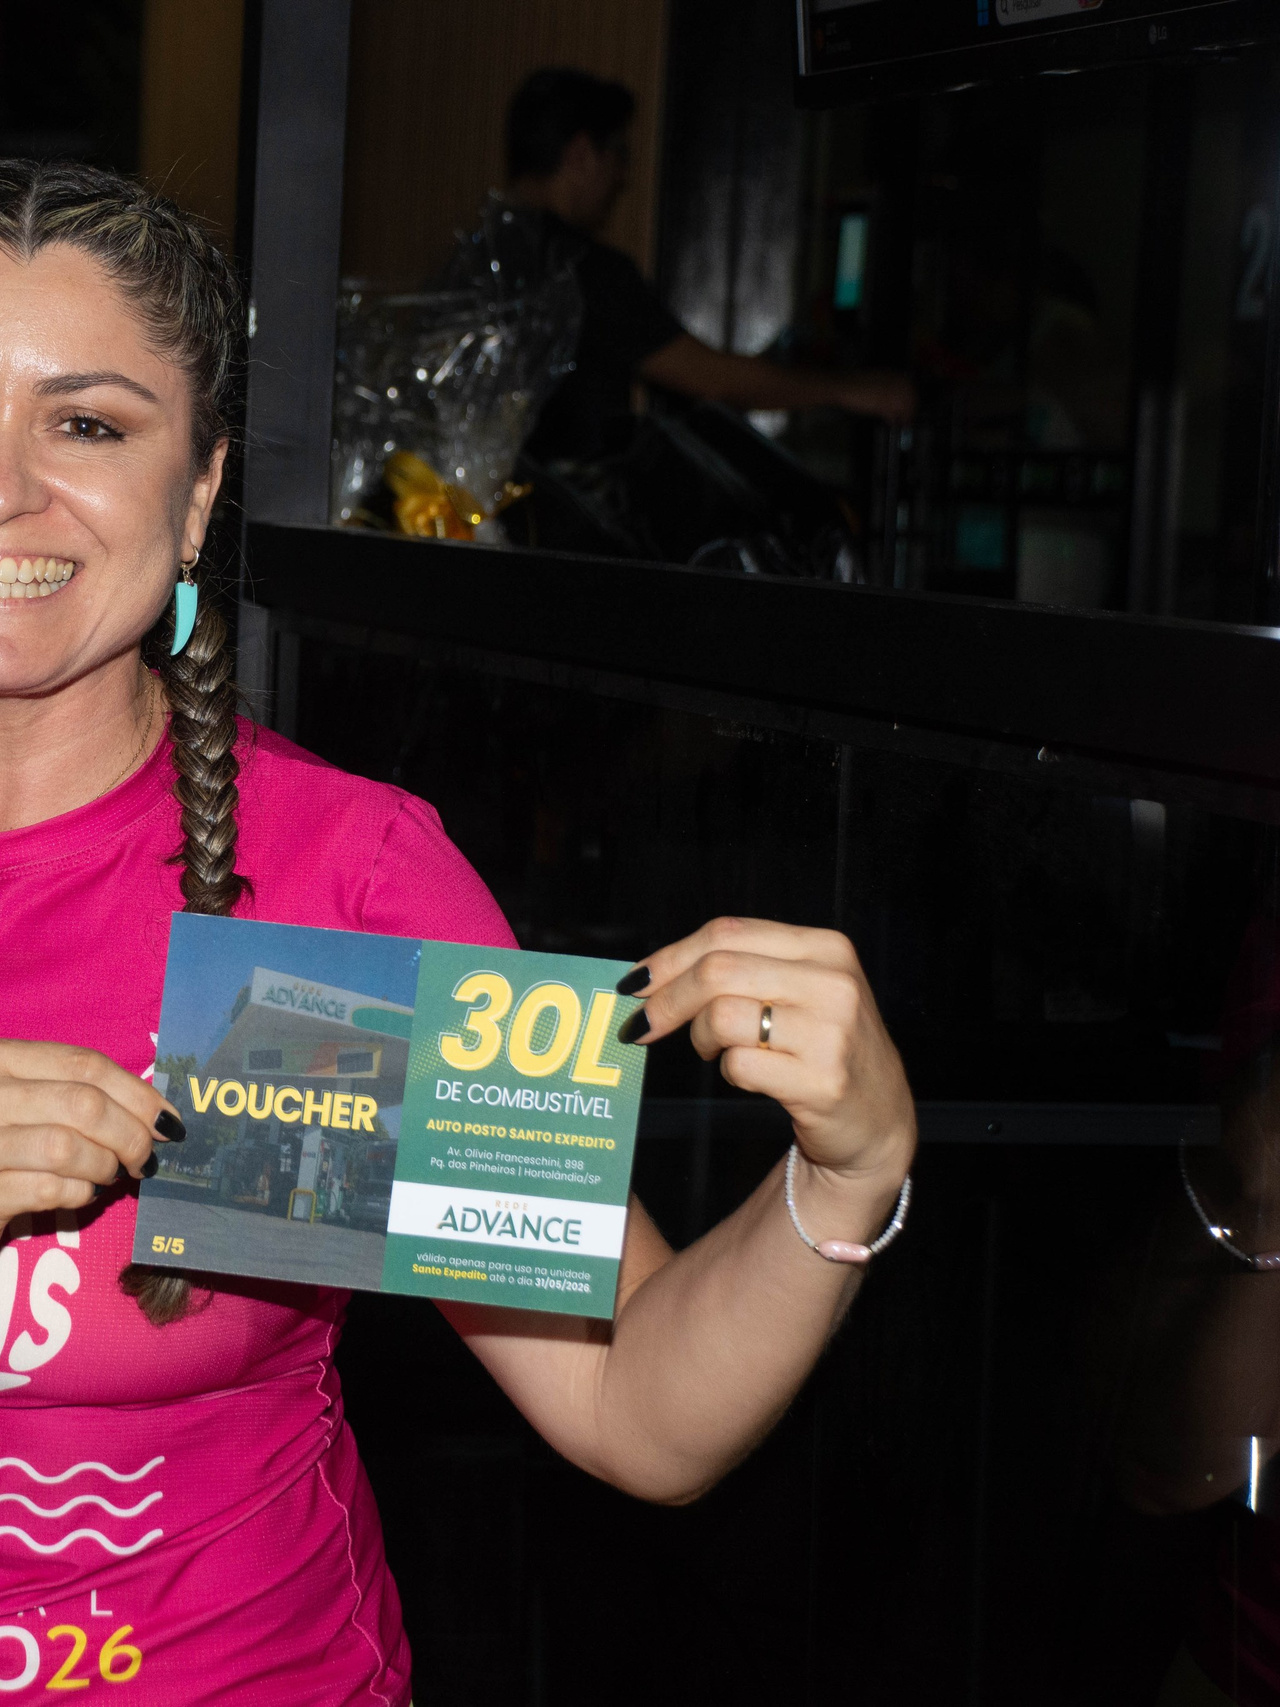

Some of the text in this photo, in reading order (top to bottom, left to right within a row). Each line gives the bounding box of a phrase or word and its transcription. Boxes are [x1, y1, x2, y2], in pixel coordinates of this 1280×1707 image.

[1157, 25, 1168, 40] LG
[262, 984, 347, 1020] ADVANCE
[438, 969, 622, 1087] 30L
[187, 1074, 378, 1132] VOUCHER
[435, 1079, 614, 1119] DE COMBUSTÍVEL
[426, 1118, 616, 1150] AUTO POSTO SANTO EXPEDITO
[430, 1156, 445, 1169] Pq.
[448, 1157, 467, 1170] dos
[469, 1161, 516, 1176] Pinheiros
[524, 1168, 601, 1185] Hortolândia/SP
[447, 1146, 585, 1171] Av. Olívio Franceschini, 898
[495, 1199, 529, 1211] REDE
[436, 1205, 582, 1245] ADVANCE
[151, 1235, 185, 1255] 5/5
[412, 1263, 442, 1276] Santo
[443, 1267, 488, 1281] Expedito
[489, 1273, 506, 1283] até
[508, 1276, 515, 1284] o
[517, 1275, 533, 1286] dia
[416, 1252, 592, 1281] válido apenas para uso na unidade
